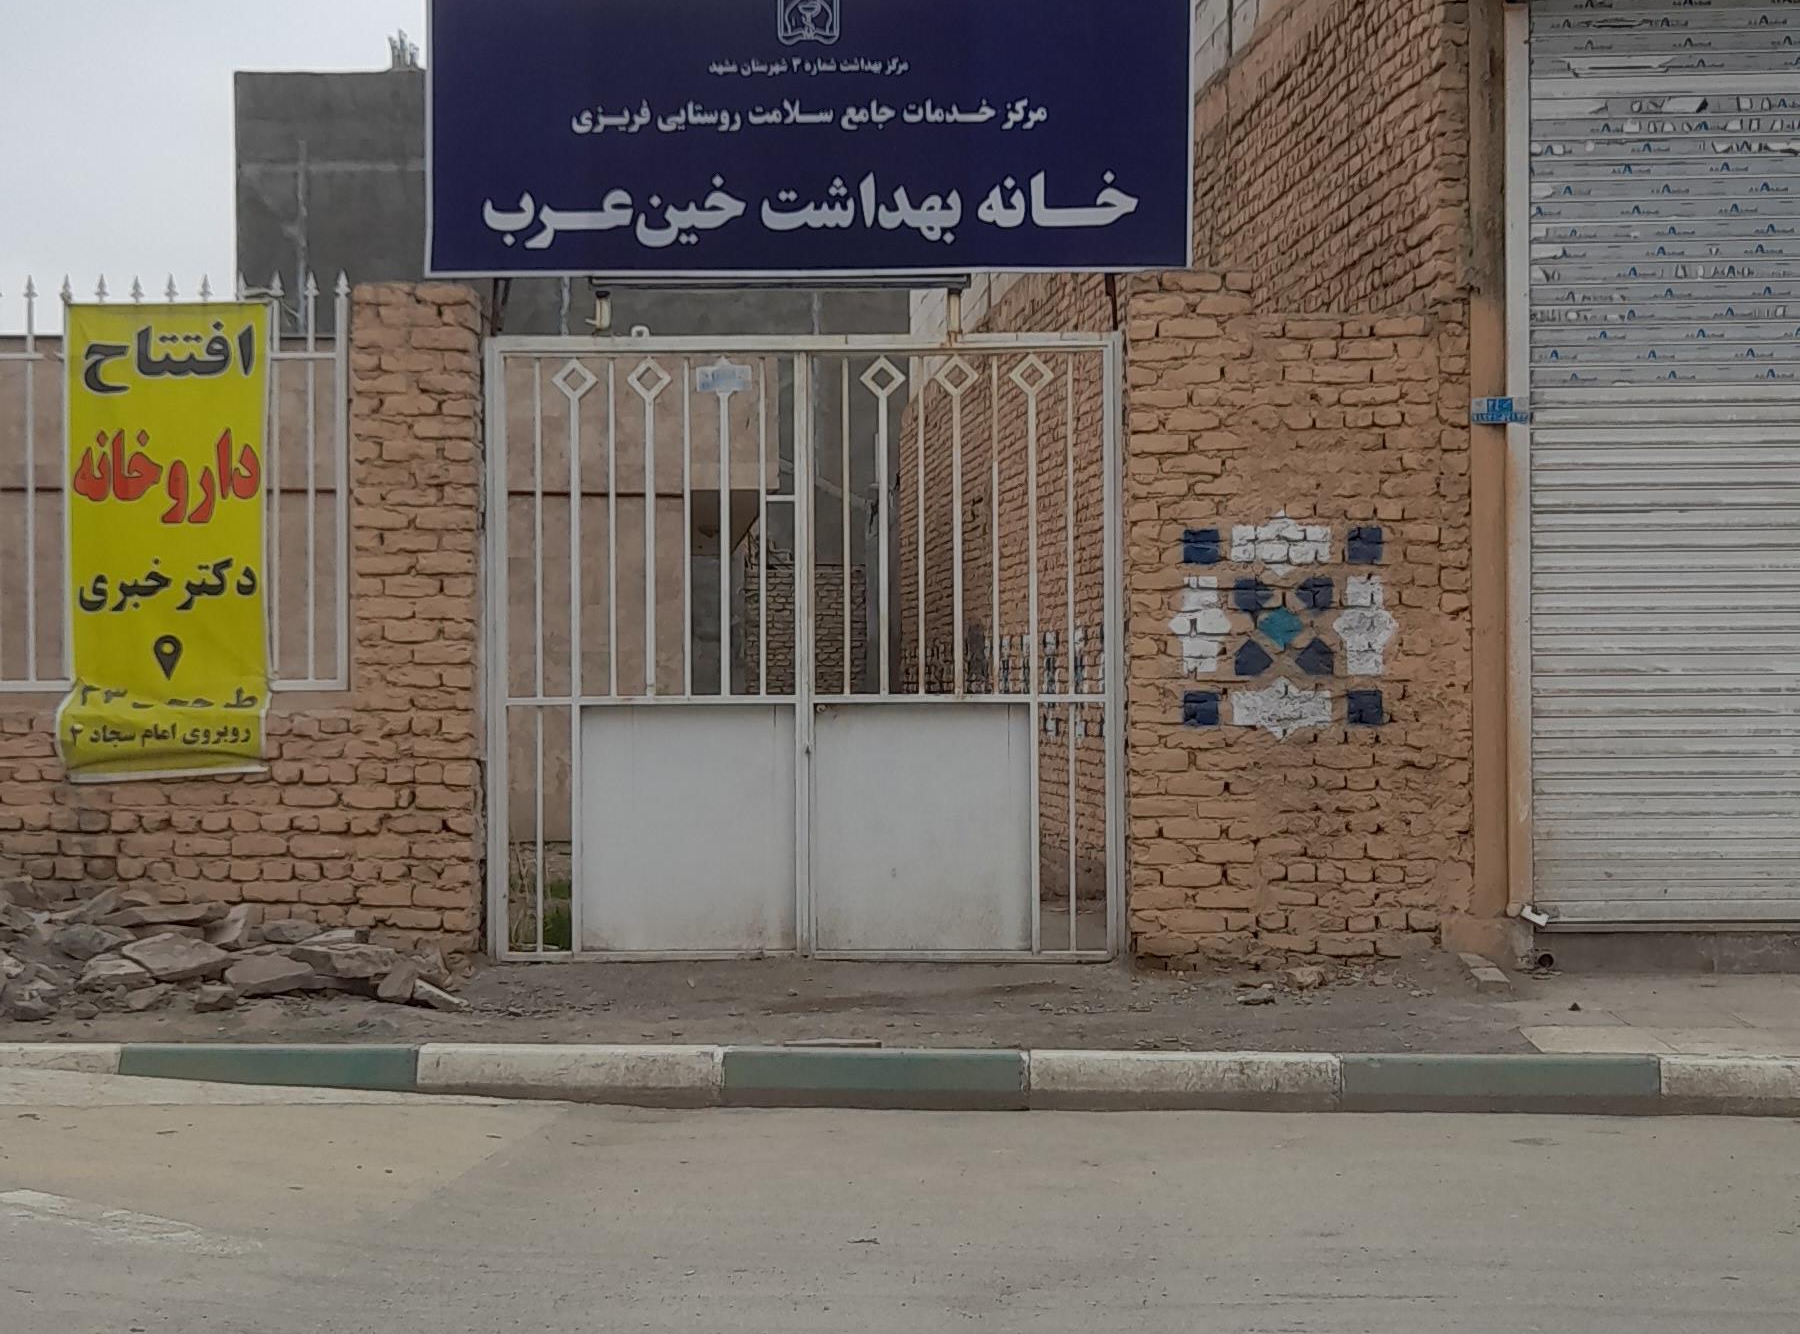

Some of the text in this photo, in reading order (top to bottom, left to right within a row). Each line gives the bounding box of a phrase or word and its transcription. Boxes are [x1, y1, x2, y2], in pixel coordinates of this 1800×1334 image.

[740, 56, 788, 77] شهرستان
[804, 56, 838, 76] شماره
[839, 56, 883, 74] بهداشت
[885, 55, 910, 76] مرکز
[570, 96, 1049, 135] مرکز خدمات جامع سلامت روستایی فریزی
[759, 171, 964, 245] بهداشت
[976, 169, 1139, 229] خانه
[83, 320, 254, 395] افتتاح
[72, 428, 262, 525] داروخانه
[77, 557, 258, 613] دکتر خبری
[88, 723, 137, 748] سجاد
[140, 722, 178, 749] امام
[181, 724, 252, 747] روبروی
